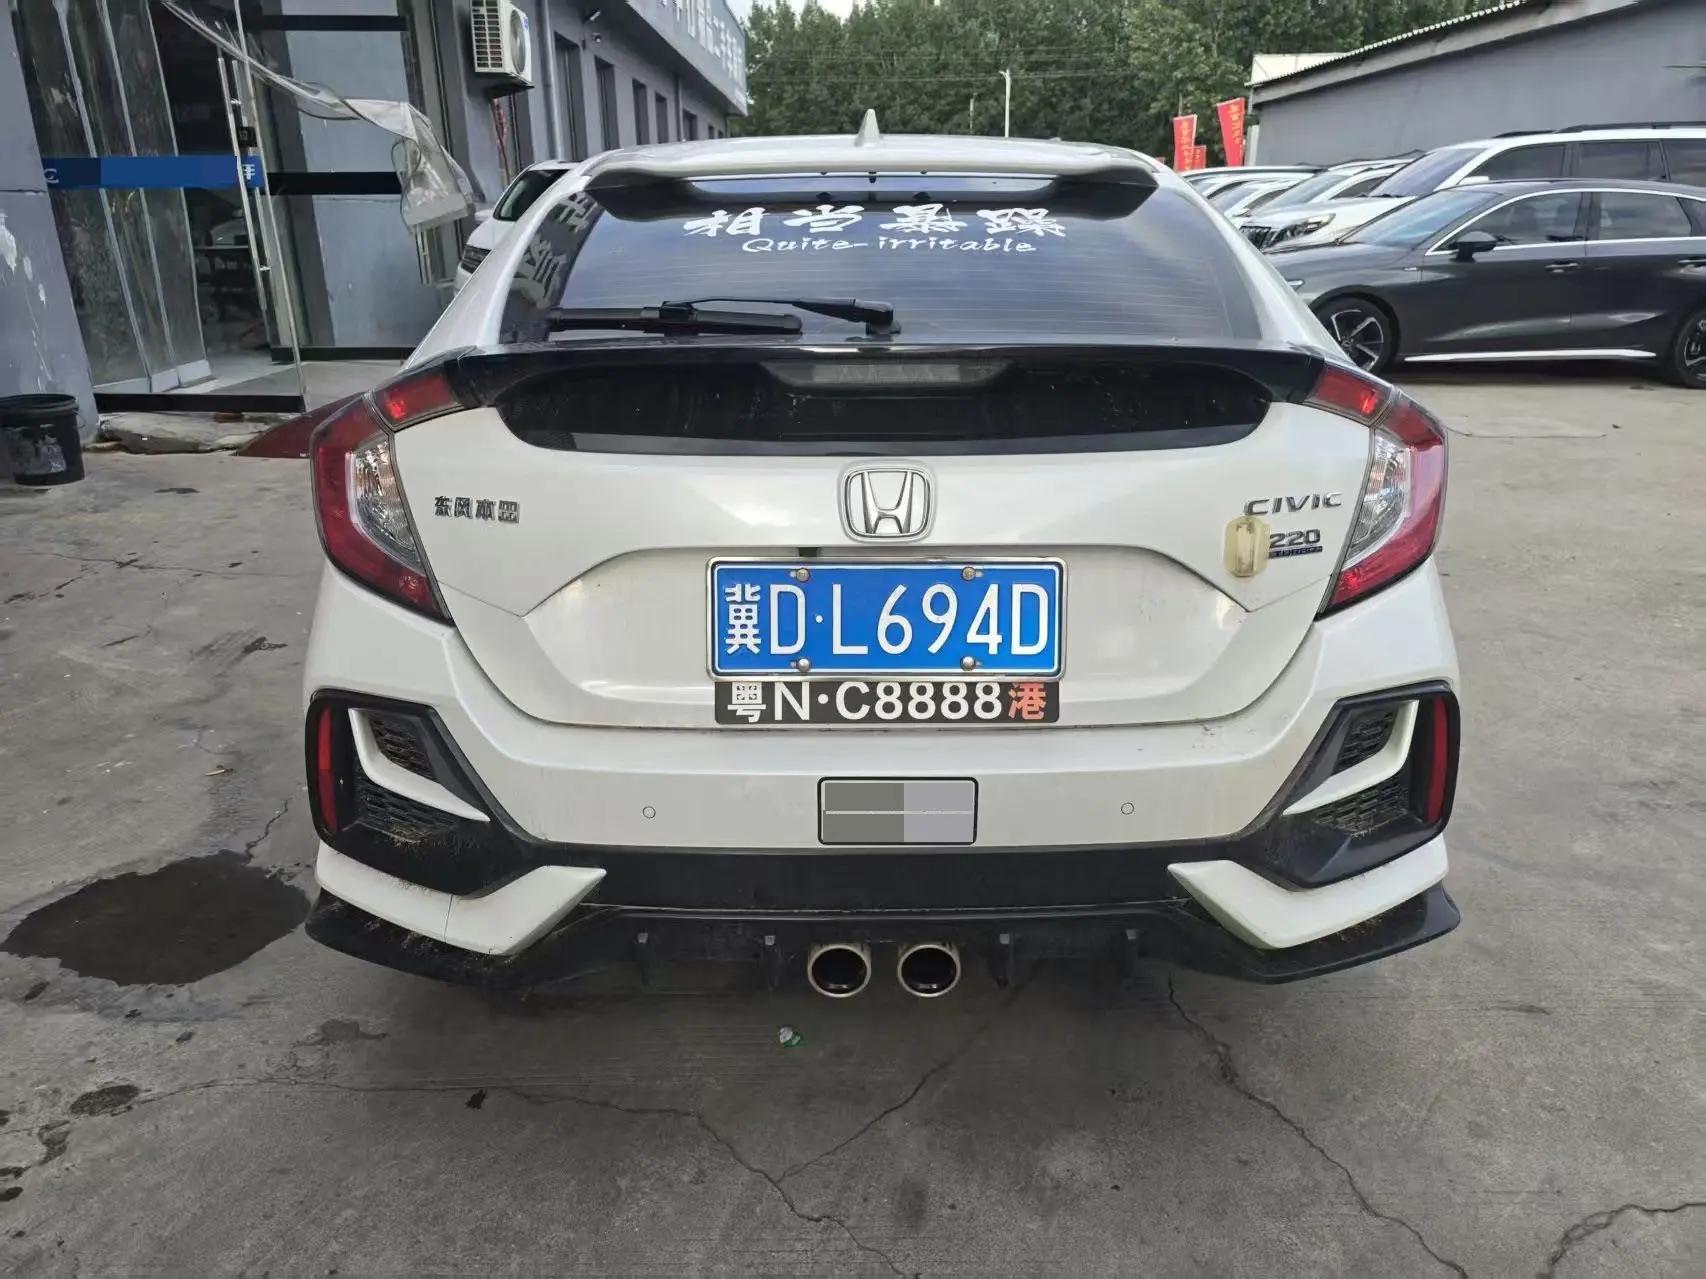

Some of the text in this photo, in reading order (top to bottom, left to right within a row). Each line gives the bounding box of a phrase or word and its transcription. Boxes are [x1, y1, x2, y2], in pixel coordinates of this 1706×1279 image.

[683, 203, 1067, 238] 相当暴躁
[878, 235, 1037, 253] irritable
[1243, 491, 1345, 516] CIVIC
[1269, 529, 1321, 548] 220
